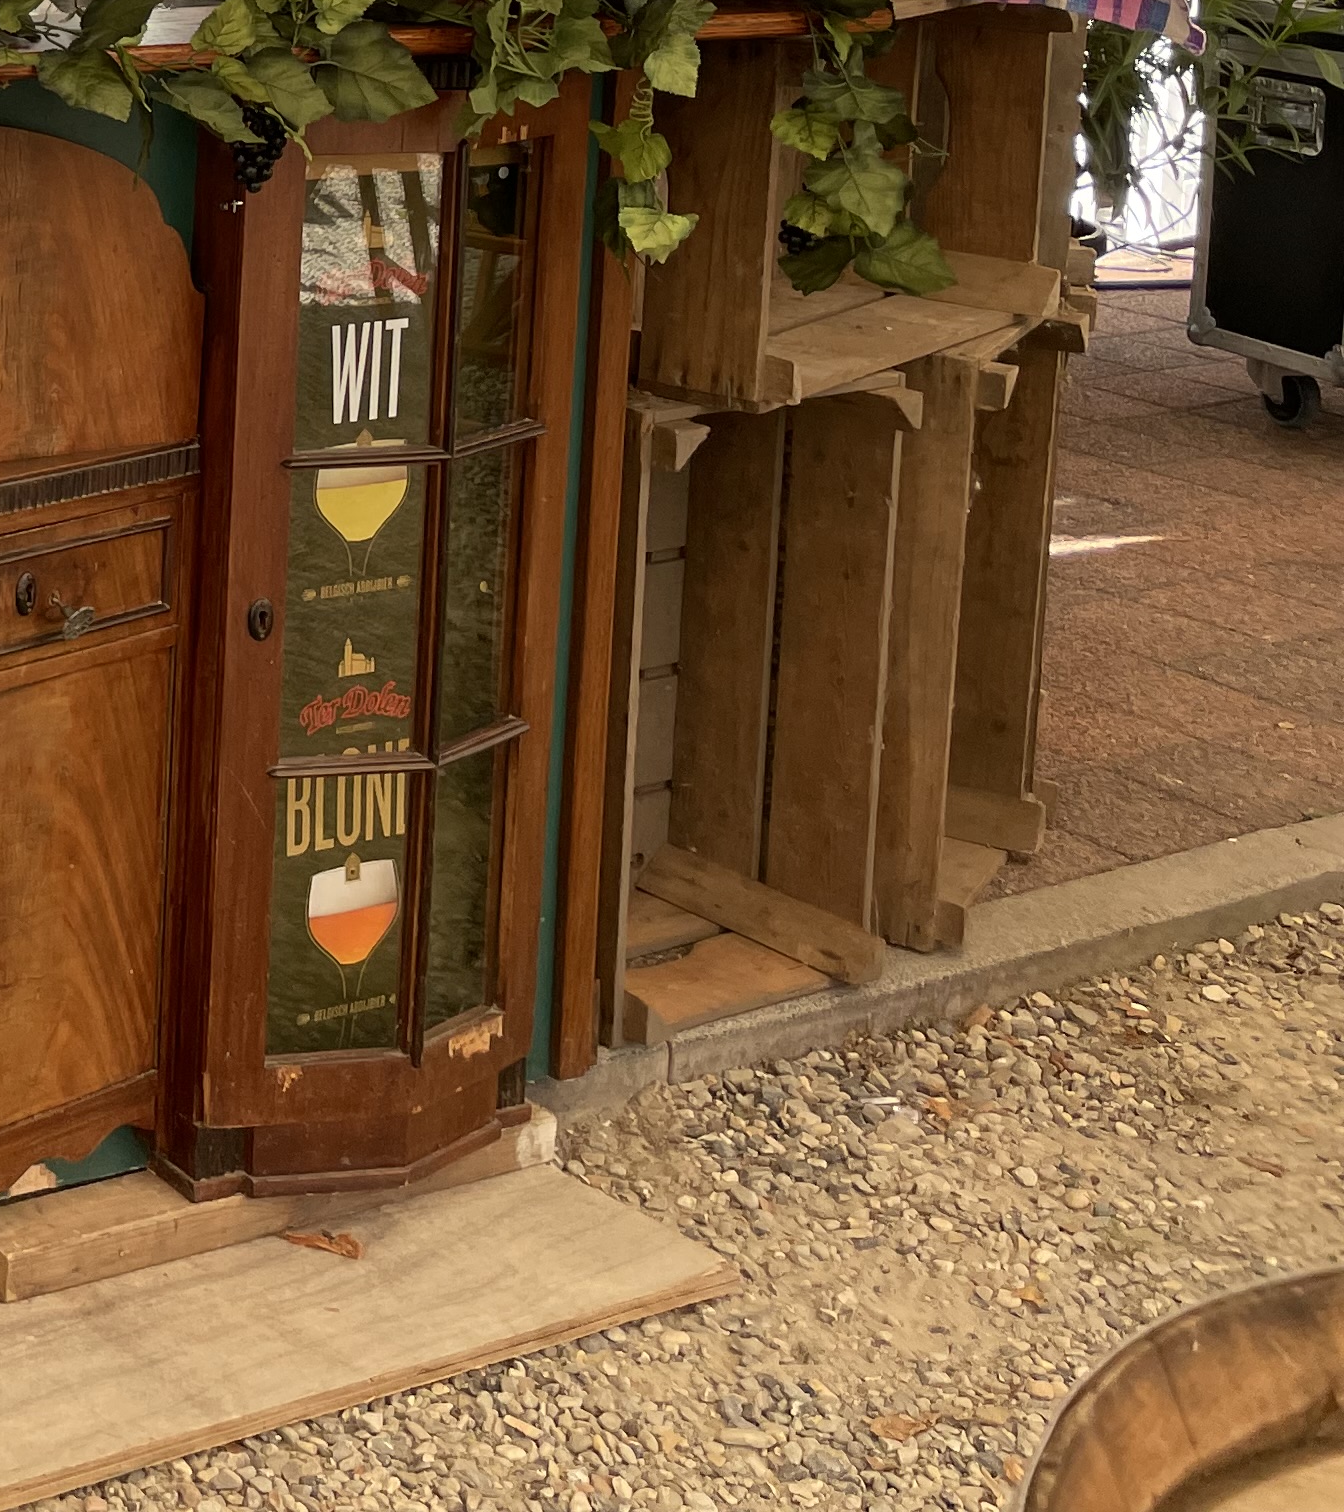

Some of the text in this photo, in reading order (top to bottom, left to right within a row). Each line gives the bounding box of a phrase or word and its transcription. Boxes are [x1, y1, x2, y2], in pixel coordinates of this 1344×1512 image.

[331, 317, 410, 424] WIT
[300, 680, 412, 736] Ter Dolen
